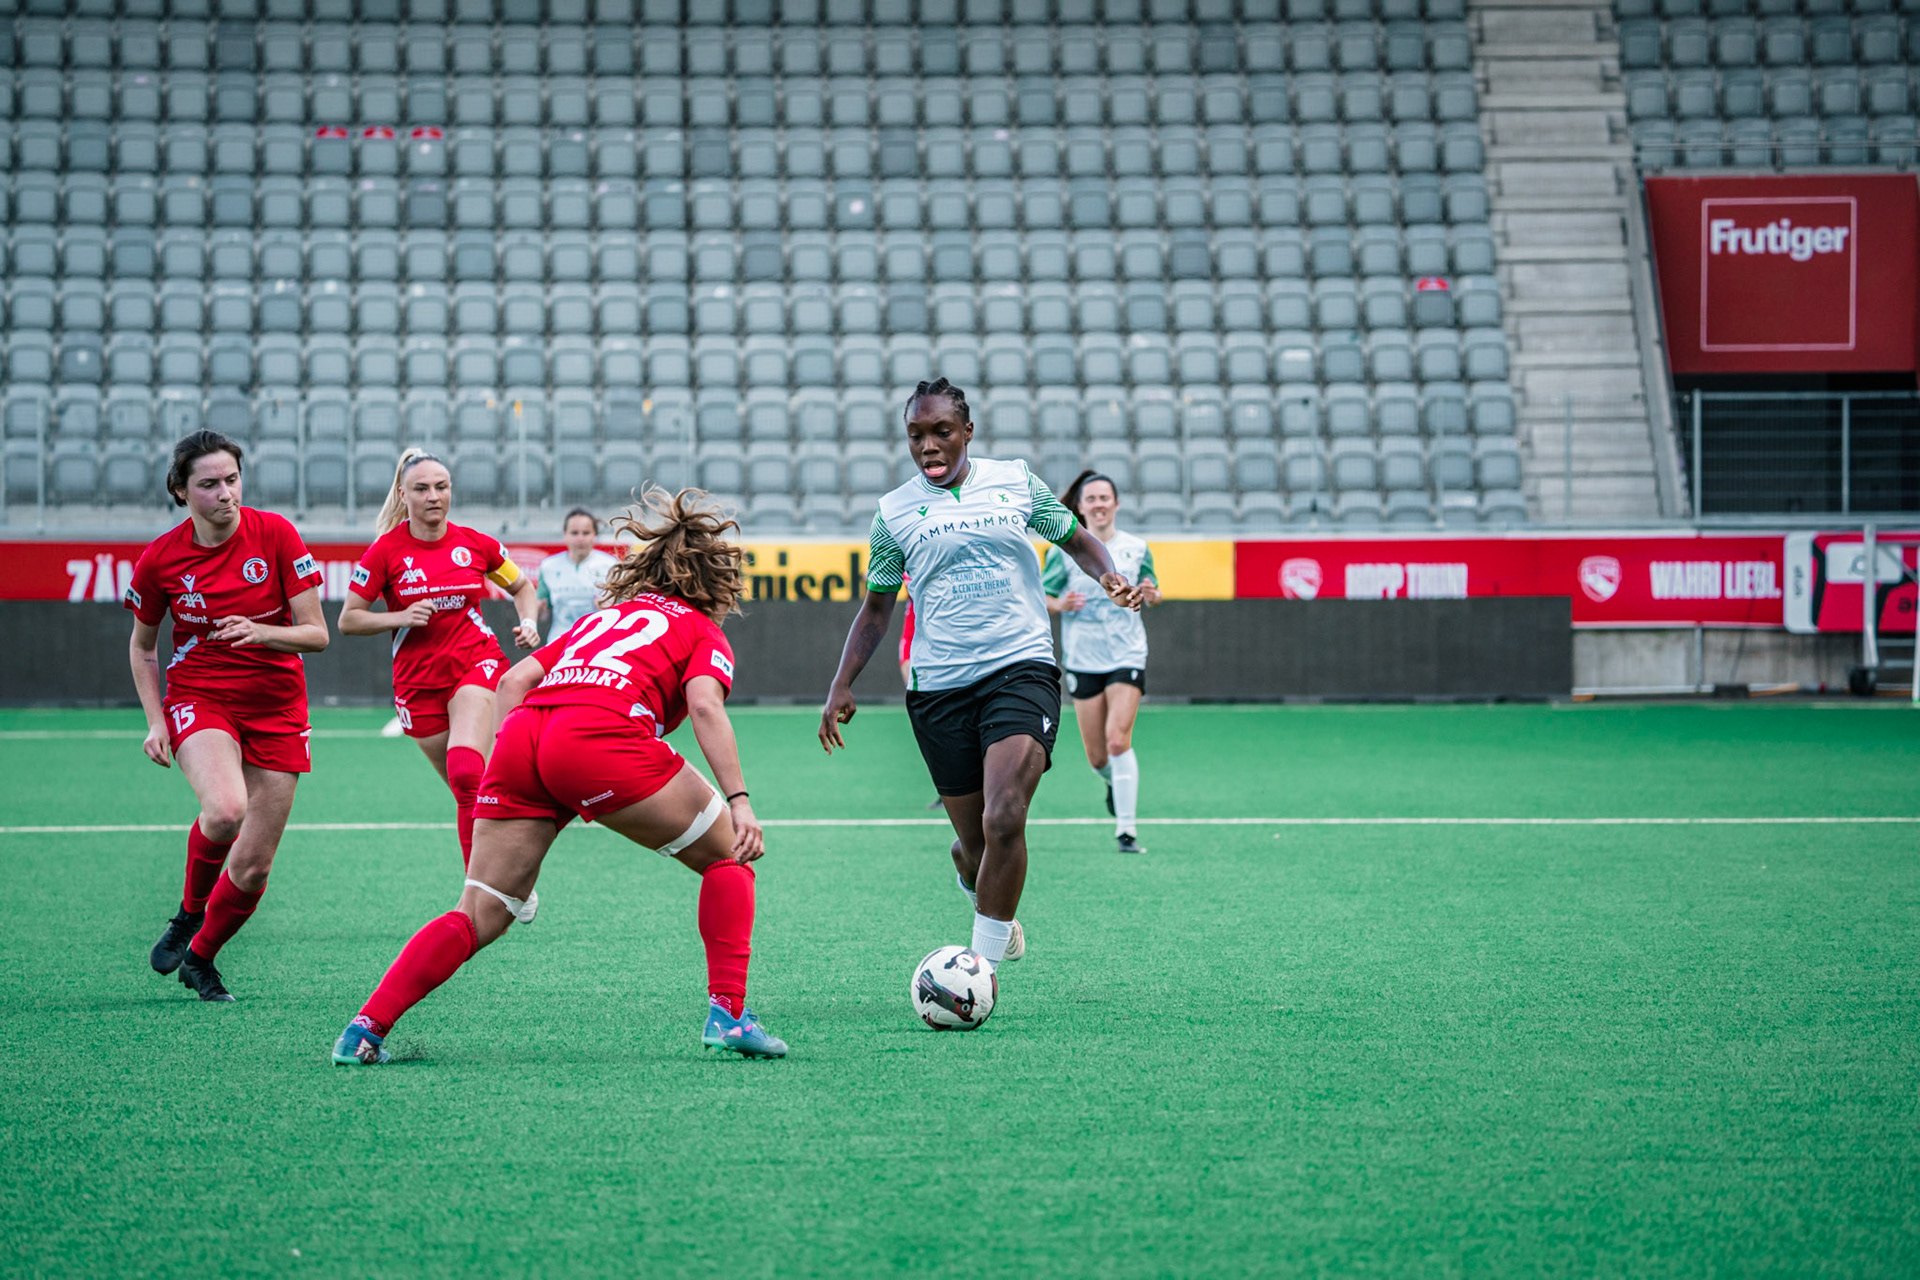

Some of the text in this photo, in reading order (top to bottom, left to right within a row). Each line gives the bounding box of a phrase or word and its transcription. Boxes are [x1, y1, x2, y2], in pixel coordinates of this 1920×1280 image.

[1710, 218, 1849, 262] Frutiger
[398, 568, 427, 584] AXA
[950, 572, 973, 583] GRAND
[1650, 561, 1722, 599] WAHRI
[399, 585, 428, 597] valiant
[952, 577, 1012, 595] & CENTRE THERMAL
[176, 592, 207, 609] AXA
[178, 612, 208, 624] valiant
[551, 608, 670, 676] 22
[172, 704, 196, 735] 15
